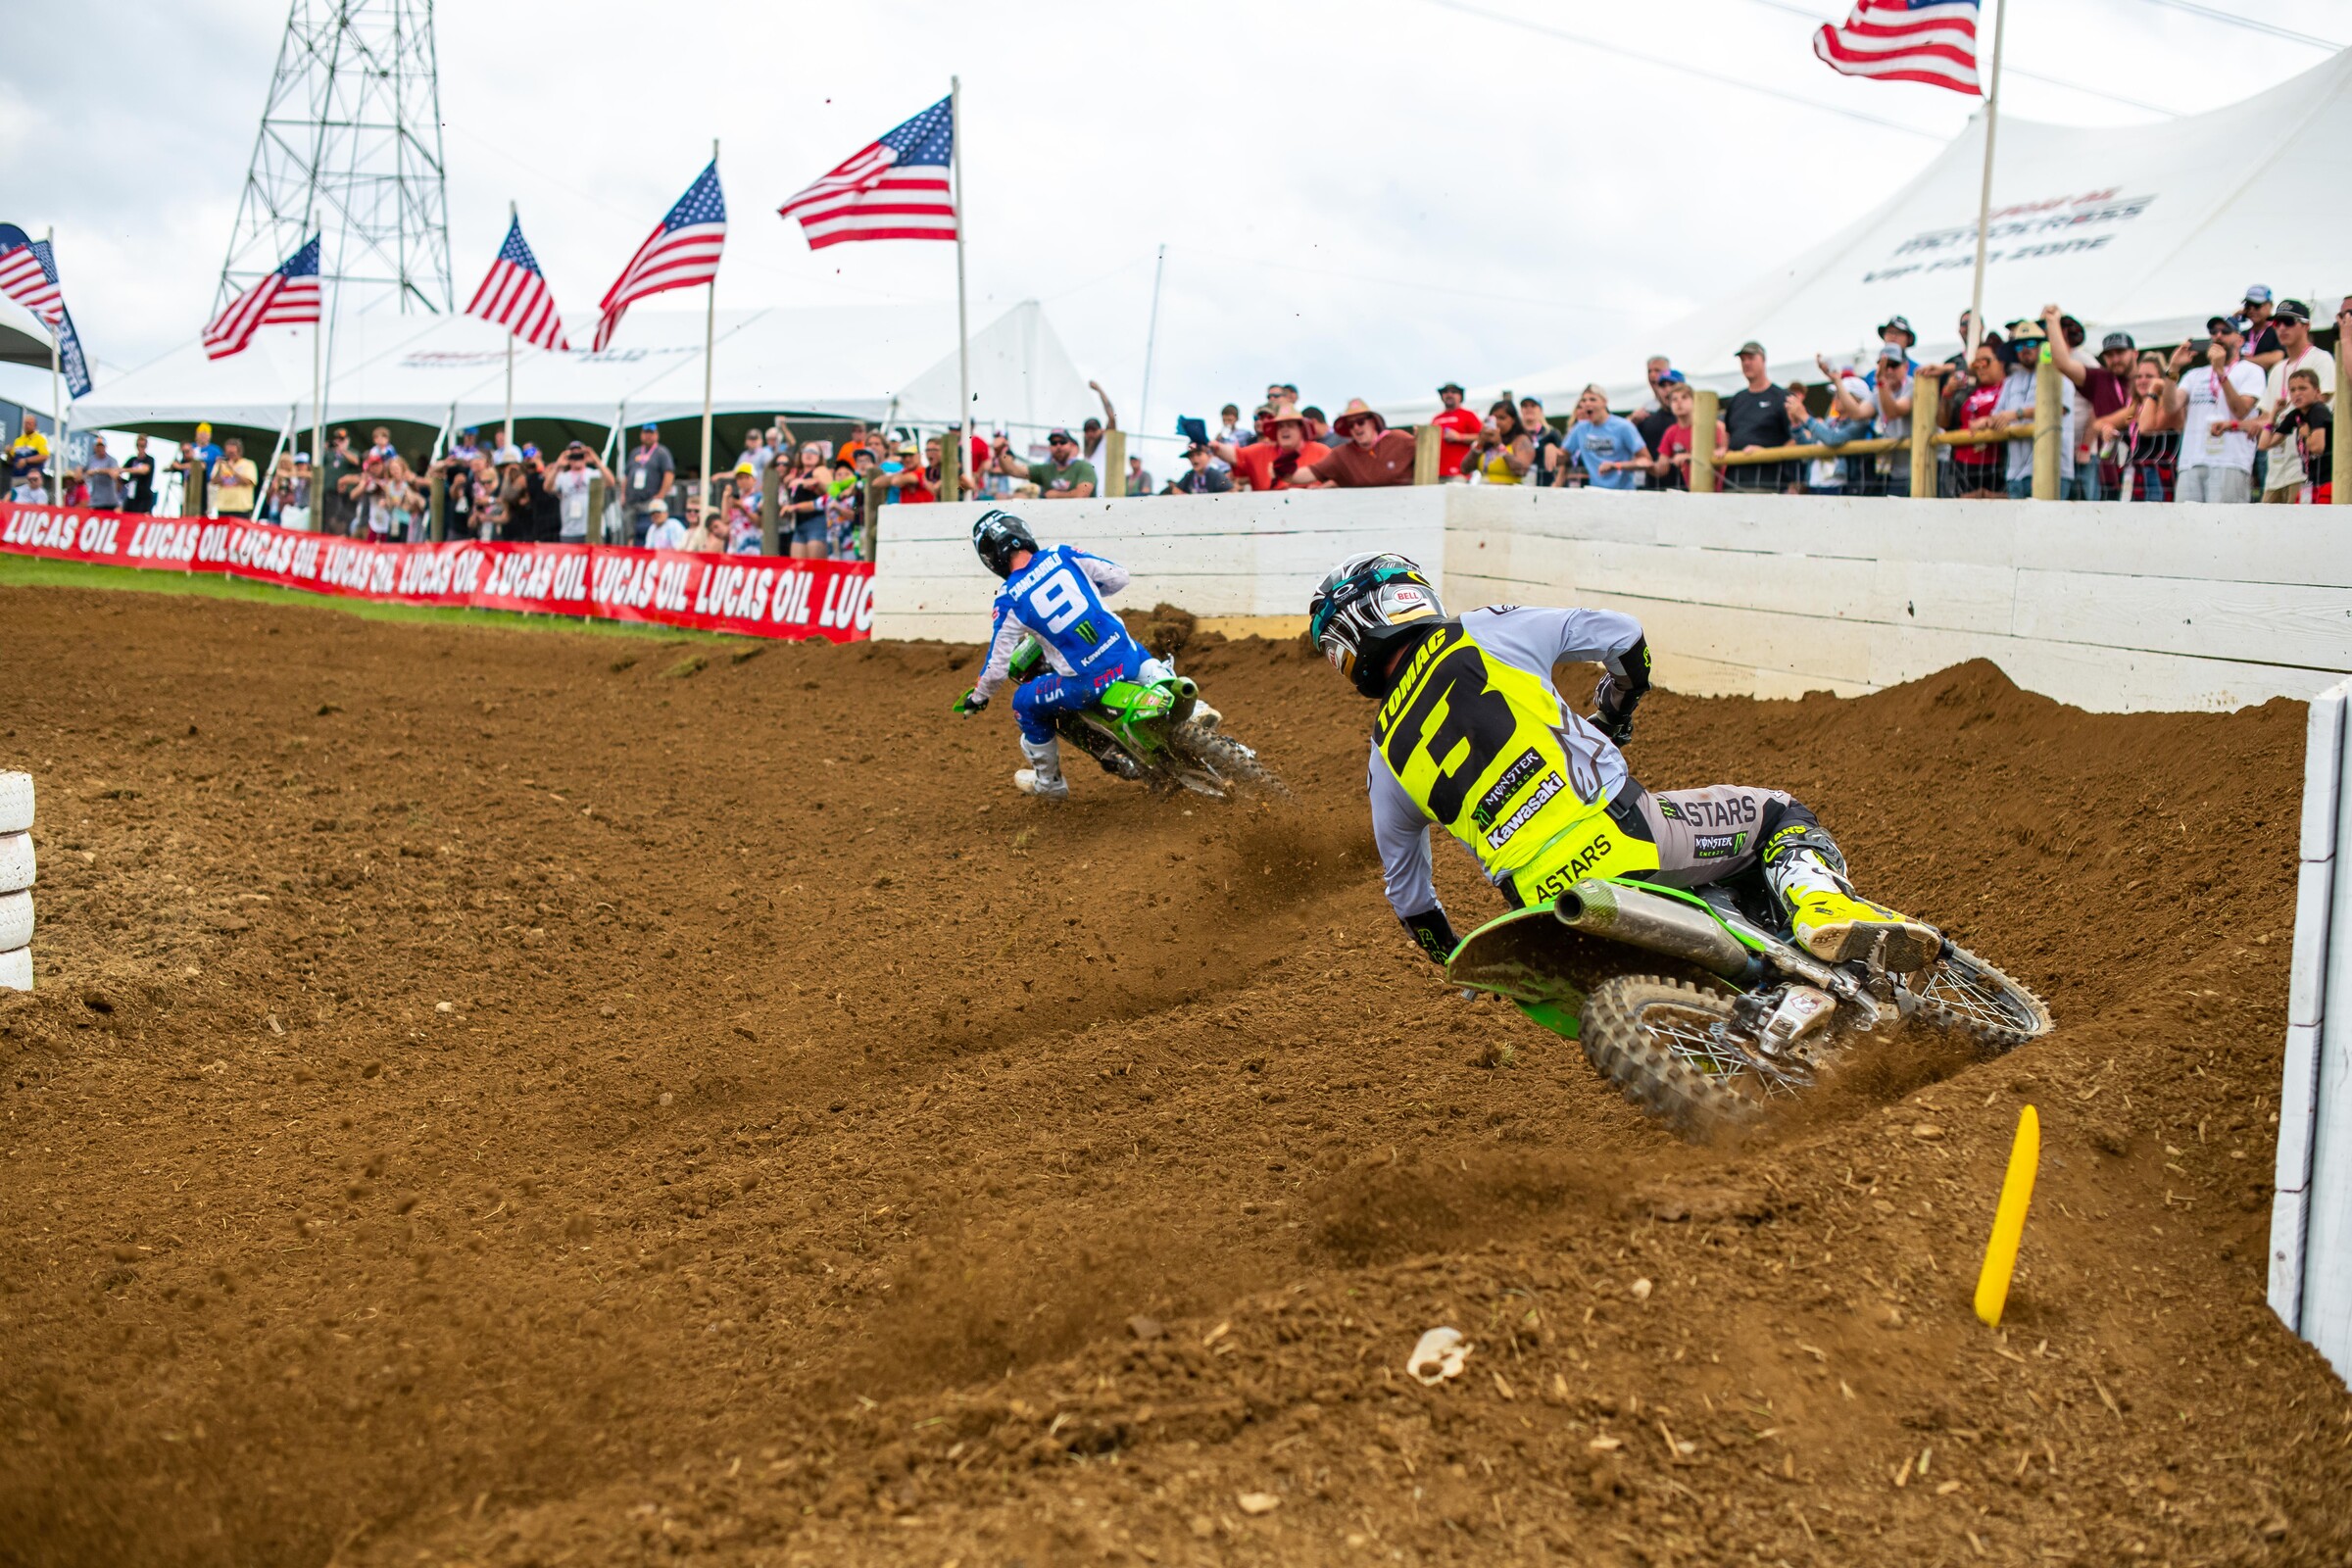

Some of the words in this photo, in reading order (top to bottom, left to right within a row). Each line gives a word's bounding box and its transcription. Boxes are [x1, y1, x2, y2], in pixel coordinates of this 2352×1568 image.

[3, 510, 79, 551] LUCAS
[78, 515, 121, 555] OIL
[126, 521, 201, 563] LUCAS
[197, 523, 229, 562] OIL
[227, 526, 296, 574] LUCAS
[291, 538, 320, 579] OIL
[320, 544, 374, 591] LUCAS
[398, 551, 455, 595] LUCAS
[453, 550, 485, 594] OIL
[484, 552, 556, 600] LUCAS
[553, 553, 588, 601] OIL
[591, 556, 659, 610] LUCAS
[656, 561, 690, 612] OIL
[694, 564, 774, 621] LUCAS
[771, 569, 814, 624] OIL
[1030, 568, 1089, 634] 9
[1396, 592, 1419, 601] BELL
[1081, 631, 1121, 667] Kawasaki
[1377, 628, 1446, 732] TOMAC
[1388, 645, 1517, 825] 3
[1485, 752, 1540, 806] MONSTER
[1500, 768, 1536, 805] ENERGY
[1487, 772, 1565, 850] Kawasaki
[1675, 796, 1757, 827] ASTARS
[1695, 836, 1733, 850] MONSTER
[1536, 834, 1612, 904] ASTARS
